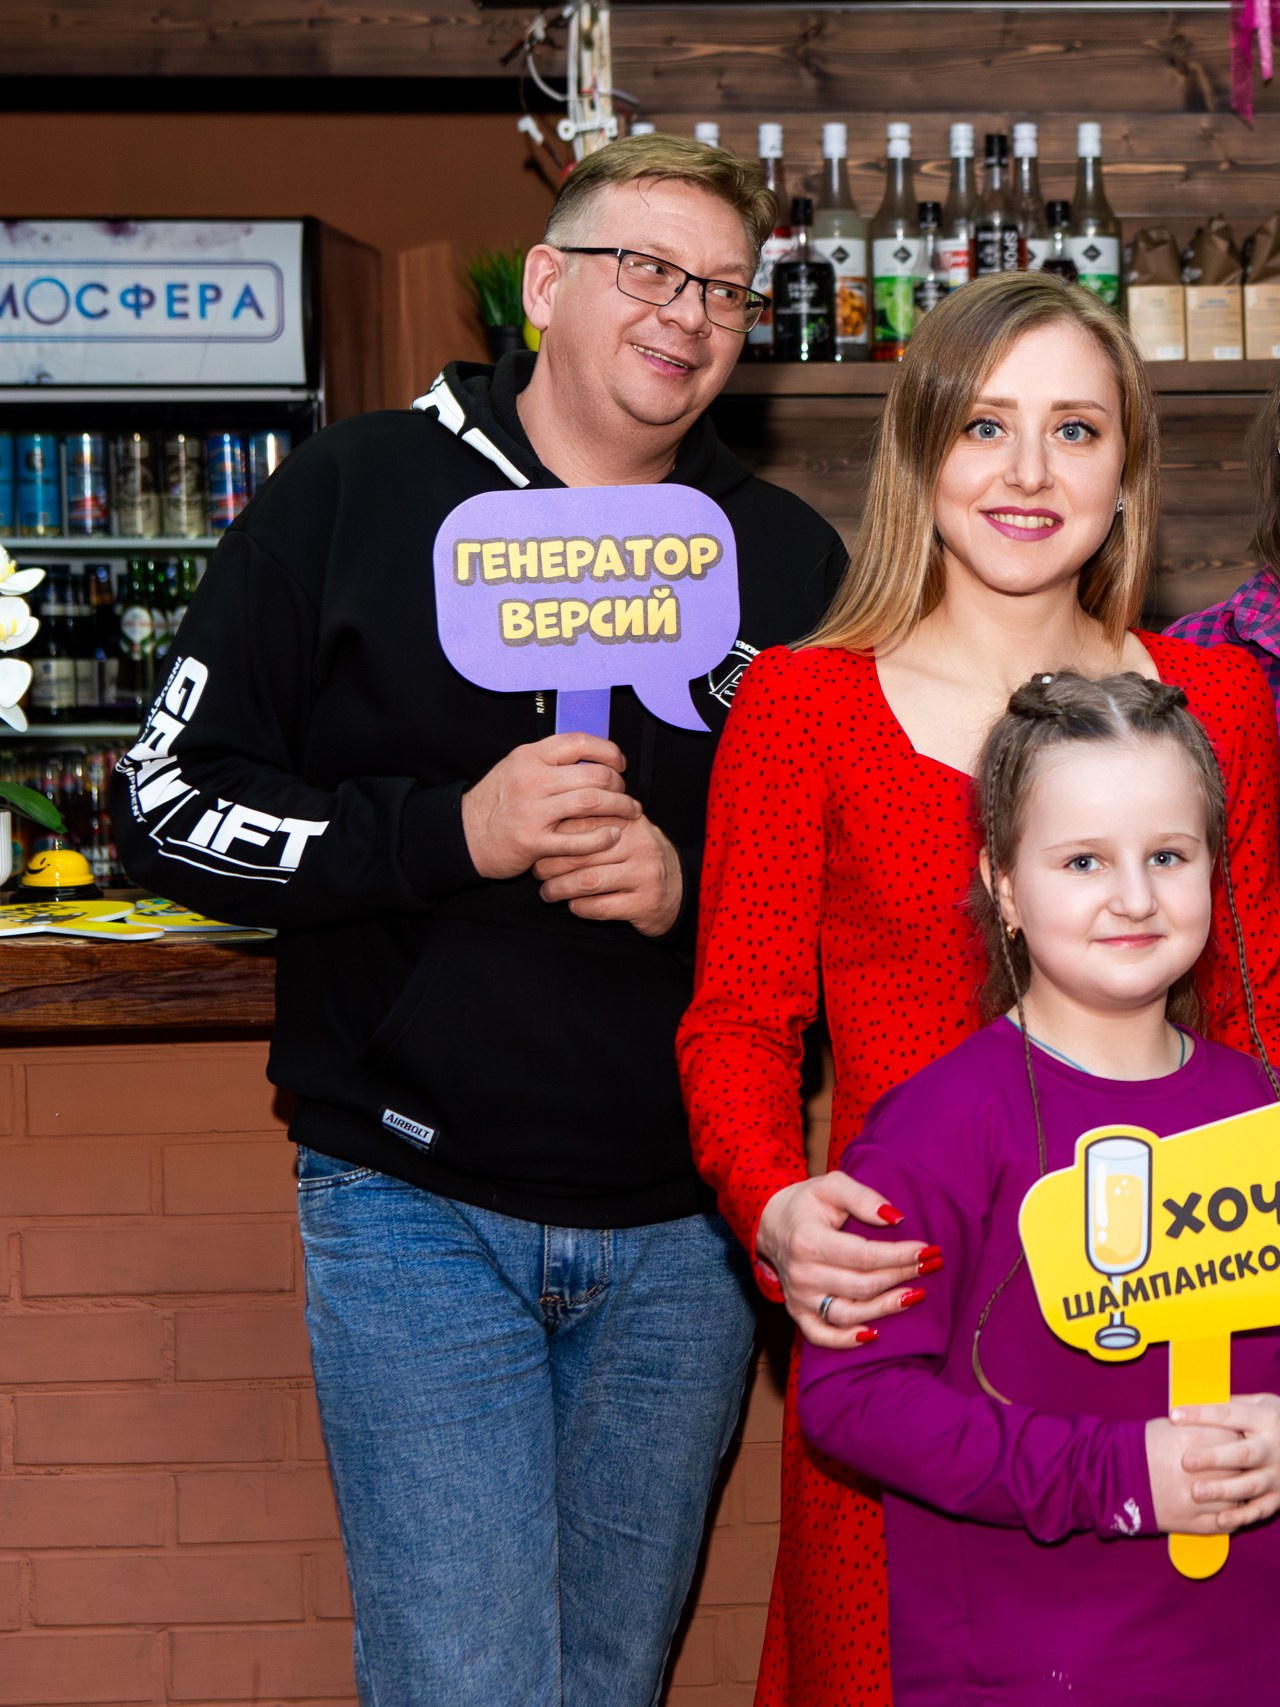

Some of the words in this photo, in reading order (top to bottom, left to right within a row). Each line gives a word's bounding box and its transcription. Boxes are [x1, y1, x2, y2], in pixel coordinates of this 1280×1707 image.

[455, 535, 721, 584] ГЕНЕРАТОР
[499, 586, 680, 645] ВЕРСИЙ
[385, 1113, 431, 1139] AIRBOLT
